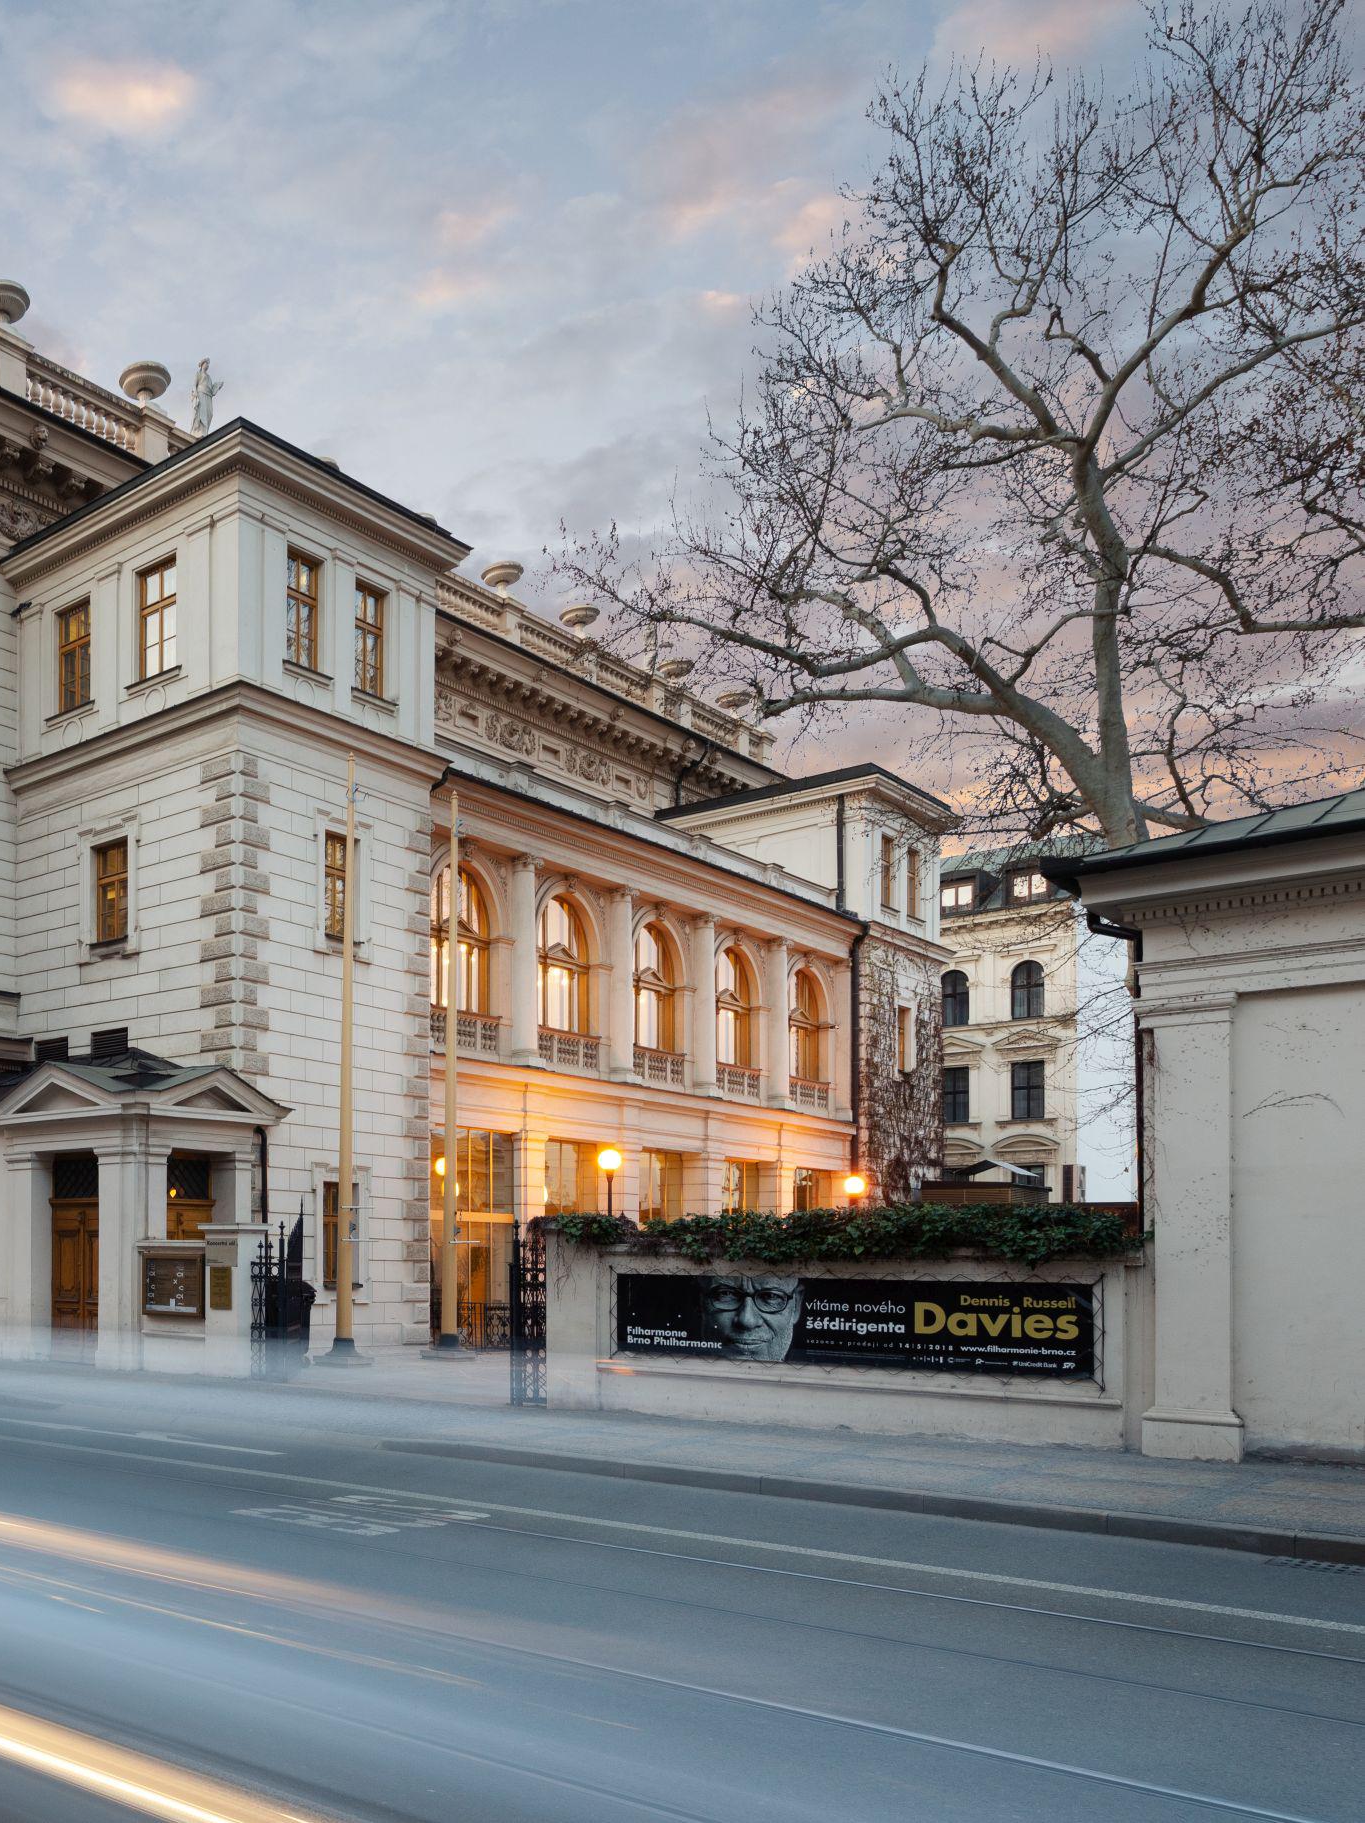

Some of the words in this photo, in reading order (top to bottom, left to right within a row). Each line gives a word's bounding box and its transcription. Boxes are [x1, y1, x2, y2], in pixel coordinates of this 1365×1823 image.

[805, 1299, 849, 1312] vítáme
[855, 1300, 906, 1314] nového
[960, 1295, 1010, 1307] Dennis
[1023, 1296, 1076, 1309] Russell
[806, 1316, 905, 1335] šéfdirigenta
[914, 1301, 1079, 1340] Davies
[627, 1326, 687, 1338] Filharmonie
[627, 1335, 651, 1345] Brno
[654, 1337, 722, 1349] Philharmonic
[960, 1344, 1076, 1357] www.filharmonie-brno.cz
